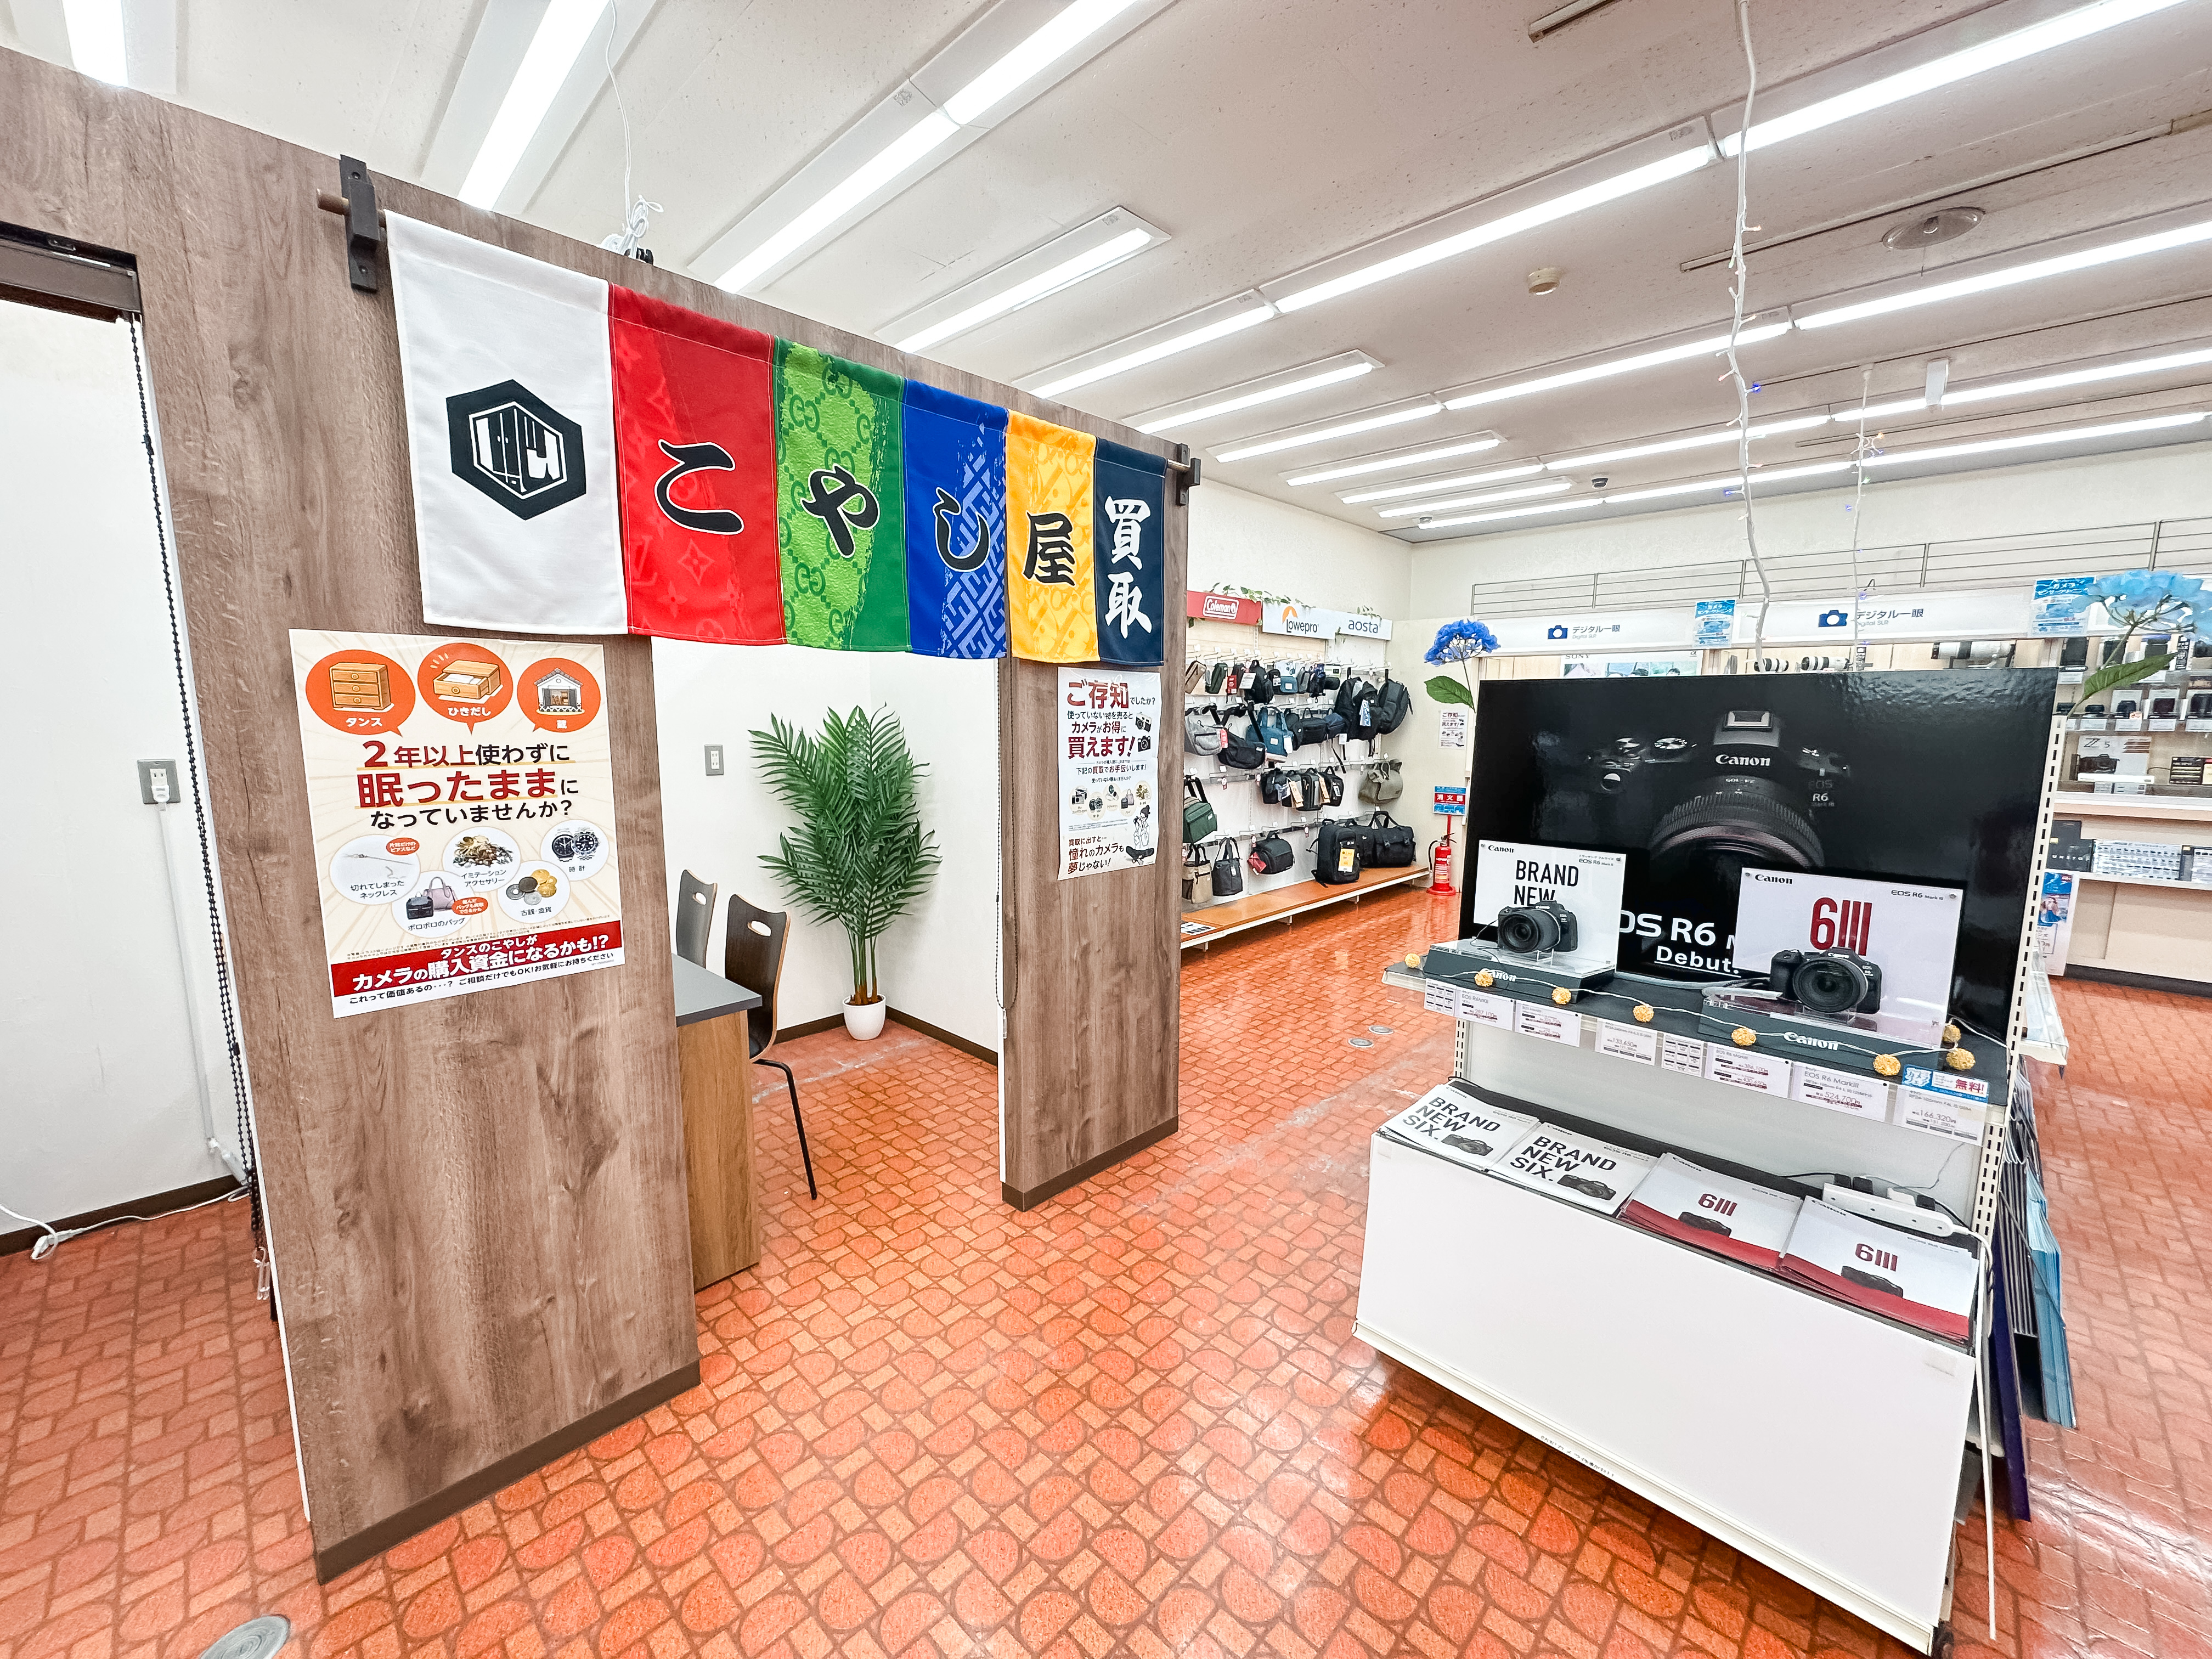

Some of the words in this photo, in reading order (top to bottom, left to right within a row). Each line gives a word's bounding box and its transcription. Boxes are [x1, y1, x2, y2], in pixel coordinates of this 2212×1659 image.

[1103, 495, 1153, 639] 買取
[1206, 599, 1231, 613] Coleman
[1286, 619, 1317, 634] Lowepro
[1348, 619, 1379, 634] aosta
[1572, 624, 1621, 634] デジタル一眼
[1067, 678, 1155, 709] ご存知でしたか?
[448, 706, 492, 717] ひきだし
[346, 716, 383, 728] タンス
[556, 719, 567, 730] 蔵
[1071, 721, 1126, 734] カメラがお得に
[363, 740, 570, 768] 2年以上使わずに
[1068, 736, 1136, 759] 買えます!
[1716, 754, 1770, 766] Canon
[357, 769, 579, 808] 眠ったままに
[1436, 793, 1464, 802] 消火器
[1813, 793, 1829, 802] R6
[371, 800, 572, 828] なっていませんか?
[1069, 843, 1124, 861] 憧れのカメラも
[1488, 845, 1514, 853] Canon
[461, 870, 506, 879] イミテーション
[1068, 857, 1111, 874] 夢じゃない!
[1515, 860, 1579, 887] BRAND
[350, 880, 405, 892] 切れてしまった
[464, 878, 505, 887] アクセサリー
[1754, 873, 1793, 885] Canon
[360, 889, 398, 899] ネックレス
[1514, 884, 1555, 906] NEW
[1620, 910, 1662, 937] OS
[1671, 917, 1716, 946] R6
[441, 934, 538, 960] タンスのこやしが
[352, 934, 609, 992] カメラの購入資金になるかも!?
[1656, 946, 1739, 974] Debut.
[1784, 1031, 1838, 1051] Canon
[1804, 1071, 1820, 1079] EOS
[1955, 1079, 1985, 1094] 無料!
[1415, 1105, 1467, 1132] NEW
[1428, 1096, 1500, 1132] BRAND
[1402, 1115, 1439, 1140] SIX.
[1520, 1146, 1581, 1172] NEW
[1533, 1136, 1617, 1171] BRAND
[1509, 1156, 1554, 1182] SIX.
[1698, 1193, 1738, 1217] 6III
[1855, 1243, 1898, 1272] 6III
